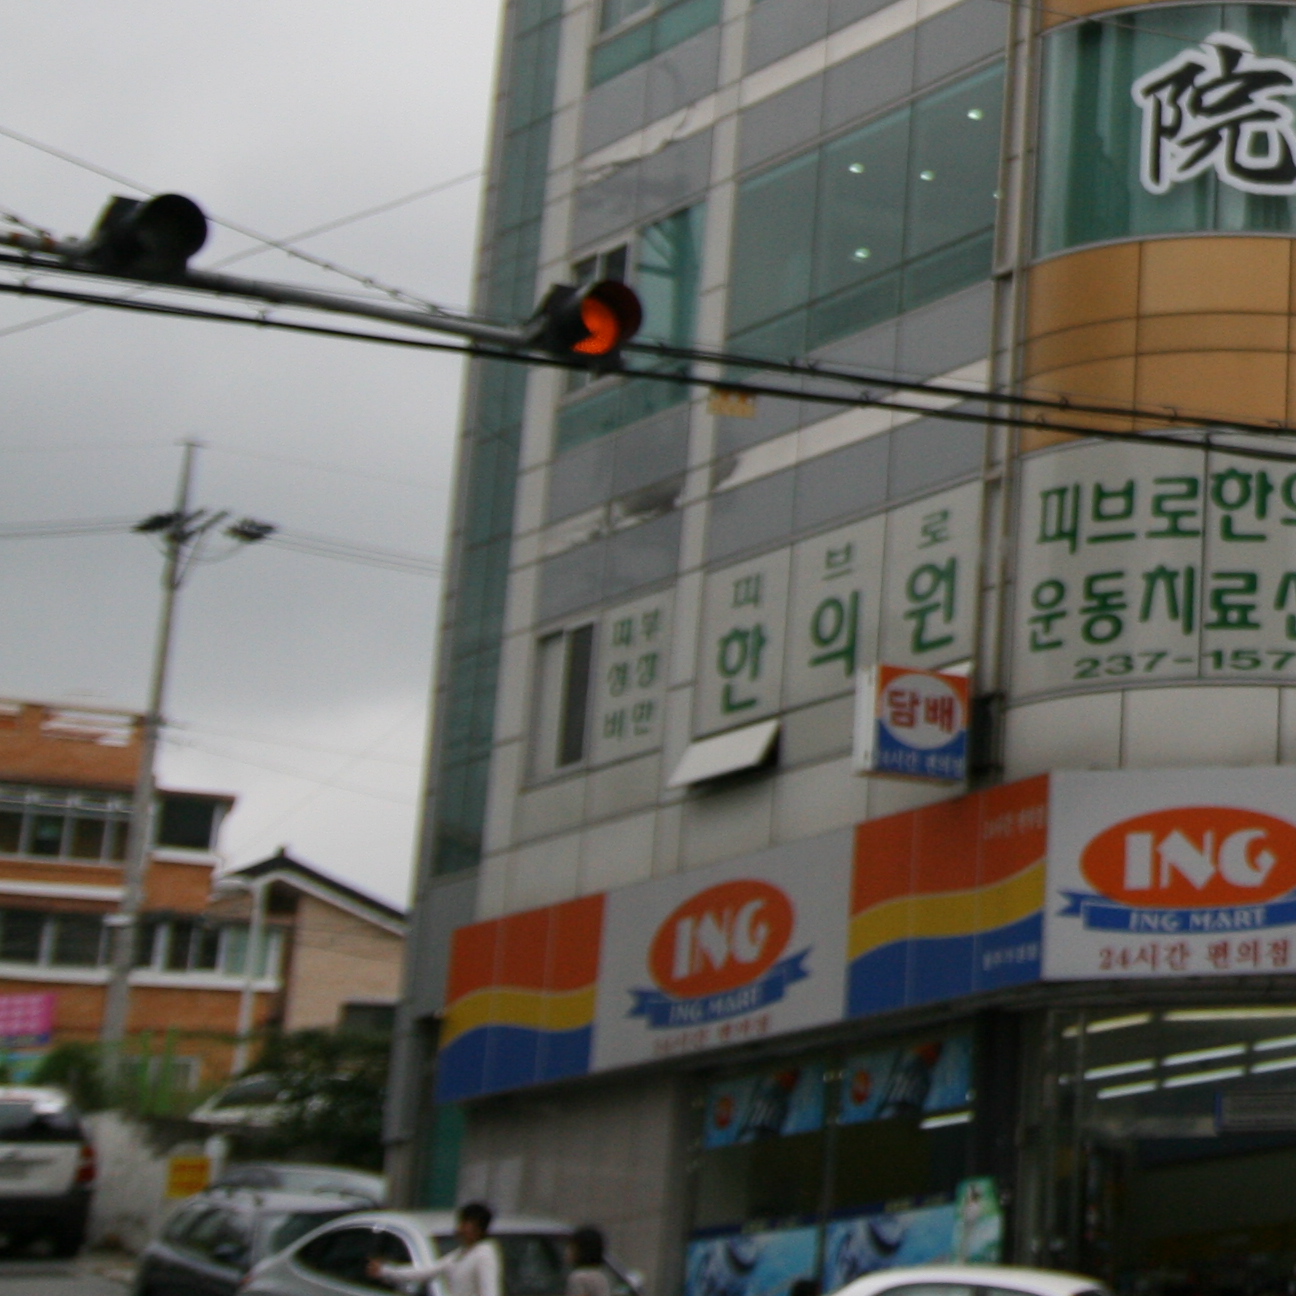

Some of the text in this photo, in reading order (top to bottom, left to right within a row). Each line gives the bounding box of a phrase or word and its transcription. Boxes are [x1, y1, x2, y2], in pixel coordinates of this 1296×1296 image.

[717, 556, 957, 716] 한의원
[888, 690, 956, 734] 담배
[1123, 827, 1277, 893] ING
[672, 899, 770, 981] ING
[1129, 907, 1269, 933] ING MART
[1098, 937, 1292, 971] 24시간 편의점
